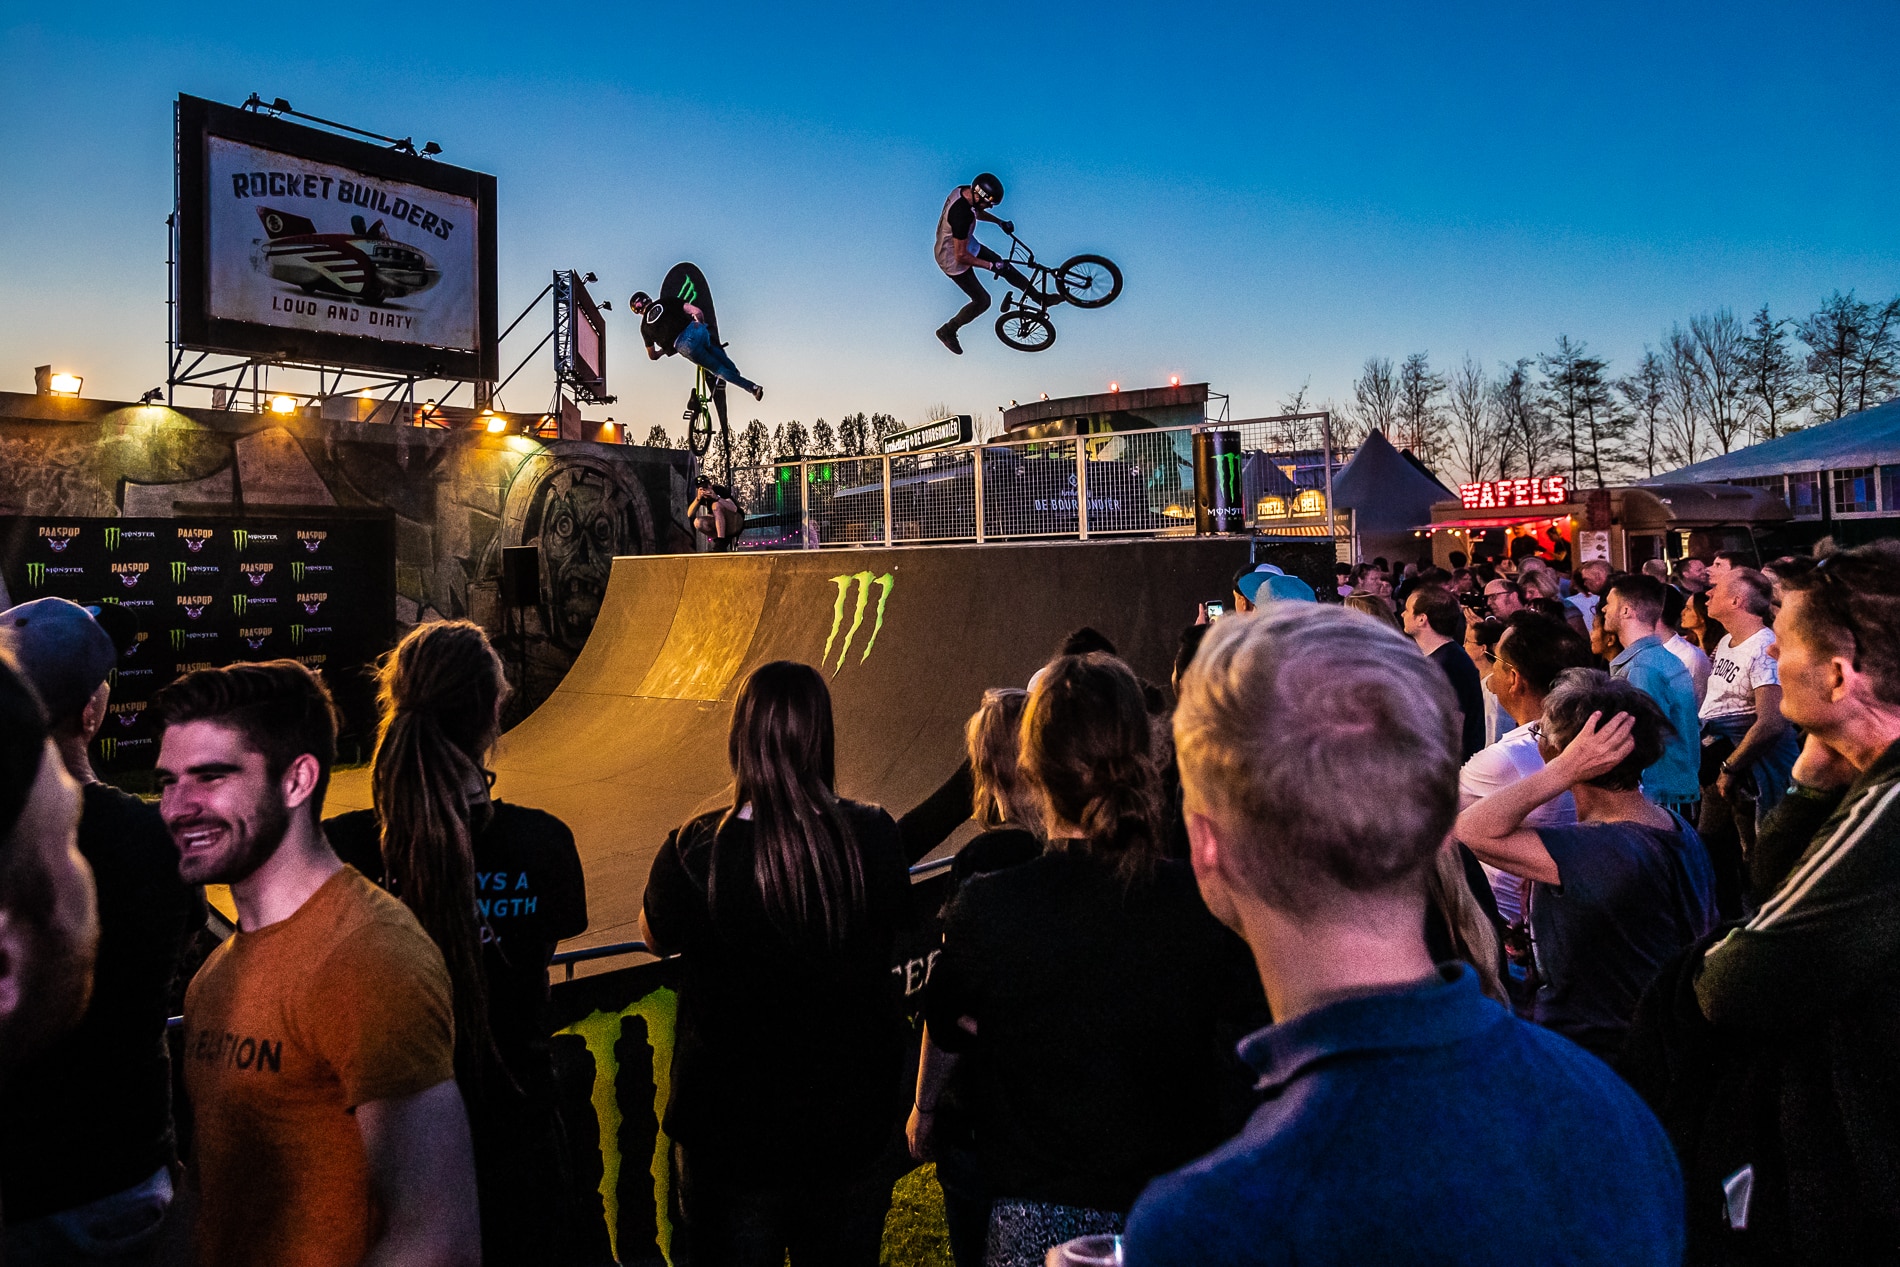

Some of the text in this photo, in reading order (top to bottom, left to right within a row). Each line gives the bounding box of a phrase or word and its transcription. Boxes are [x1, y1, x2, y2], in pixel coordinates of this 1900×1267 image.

[232, 171, 454, 241] ROCKET BUILDERS
[272, 296, 412, 329] LOUD AND DIRTY
[1460, 475, 1567, 509] WAFELS
[1050, 496, 1120, 511] BOURONDIËR
[1257, 496, 1321, 515] FRIETJE BELL
[39, 526, 80, 538] PAASPOP
[178, 528, 213, 538] PAASPOP
[297, 530, 327, 540] PAASPOP
[111, 562, 150, 573] PAASPOP
[240, 563, 274, 573] PAASPOP
[176, 595, 213, 606] PAASPOP
[297, 592, 328, 603] PAASPOP
[1713, 658, 1740, 684] BORG
[476, 871, 529, 891] YS A
[476, 895, 538, 918] NGTH
